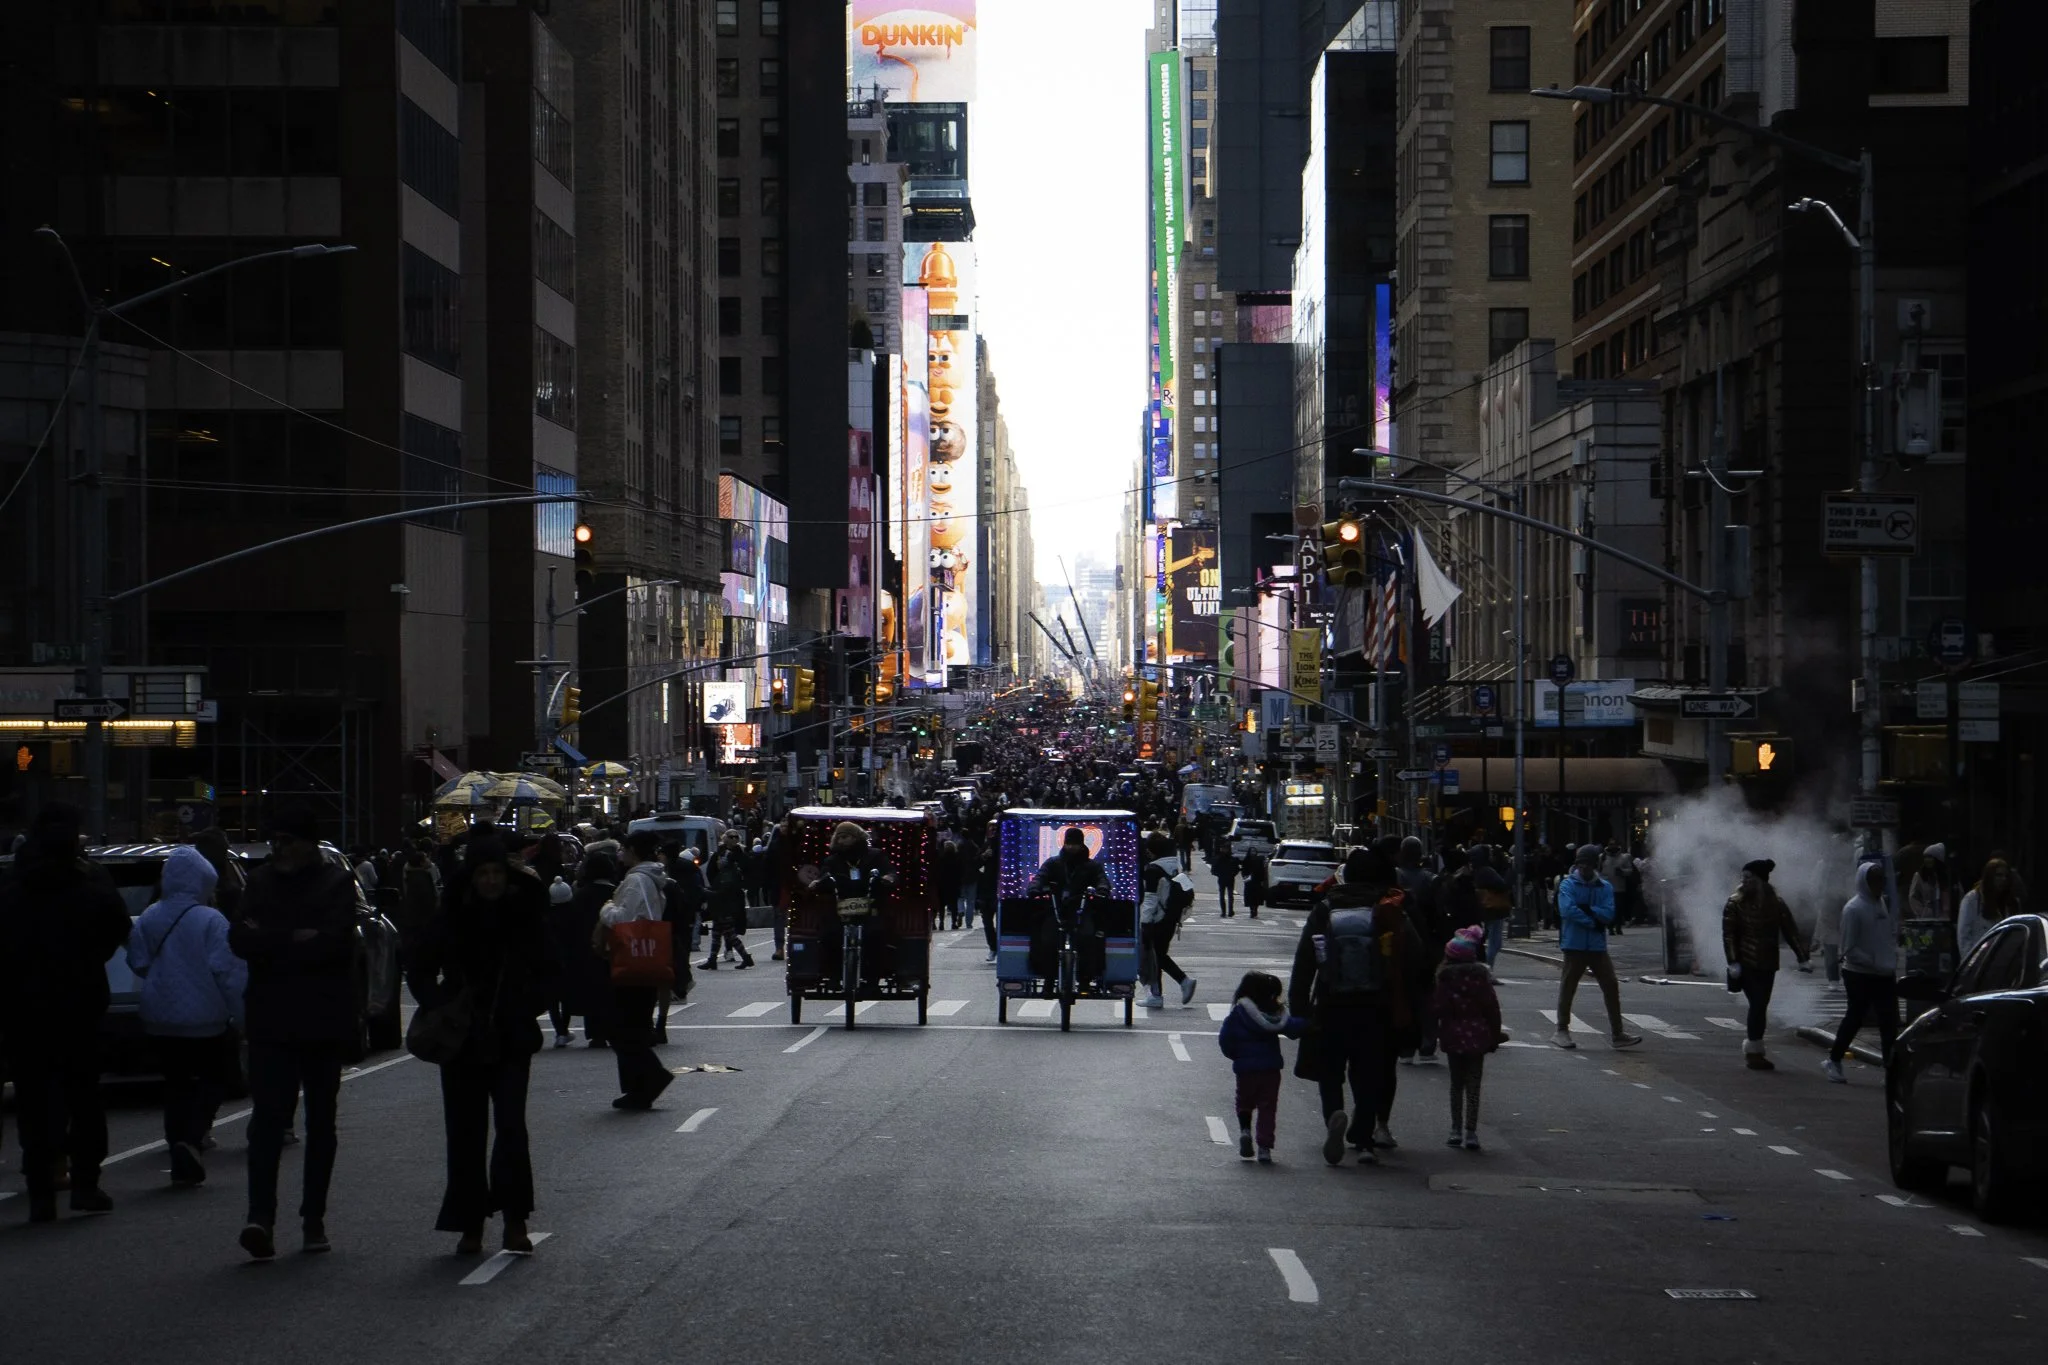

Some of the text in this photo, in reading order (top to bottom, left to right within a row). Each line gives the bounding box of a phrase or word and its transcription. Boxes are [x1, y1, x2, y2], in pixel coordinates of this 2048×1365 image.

[1160, 63, 1171, 119] SENDING
[62, 706, 116, 716] ONE WAY
[1688, 701, 1742, 711] ONE WAY
[1319, 739, 1336, 751] 25
[631, 937, 656, 958] GAP
